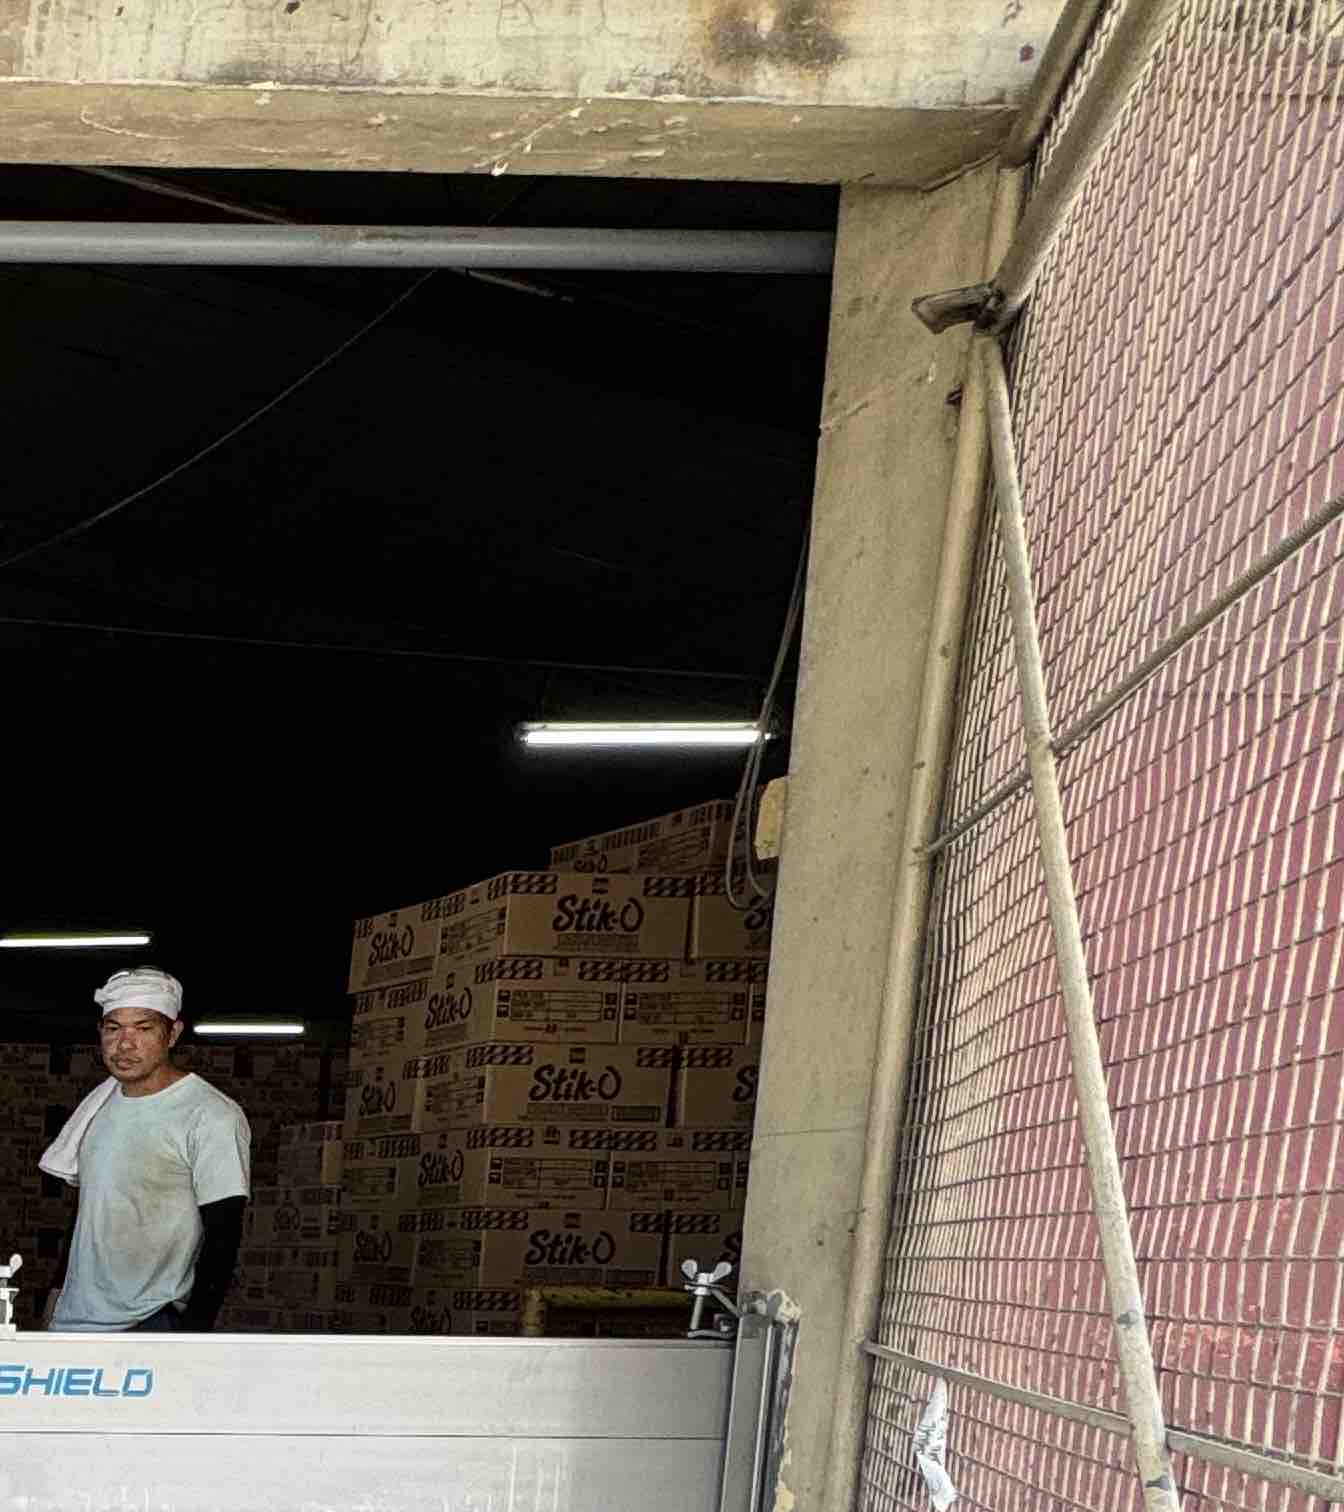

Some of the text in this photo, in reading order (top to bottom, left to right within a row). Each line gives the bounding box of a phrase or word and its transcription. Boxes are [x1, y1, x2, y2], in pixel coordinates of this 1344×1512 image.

[552, 895, 645, 932] Stik-O
[529, 1064, 622, 1101] Stik-O
[525, 1229, 616, 1265] Stik-O
